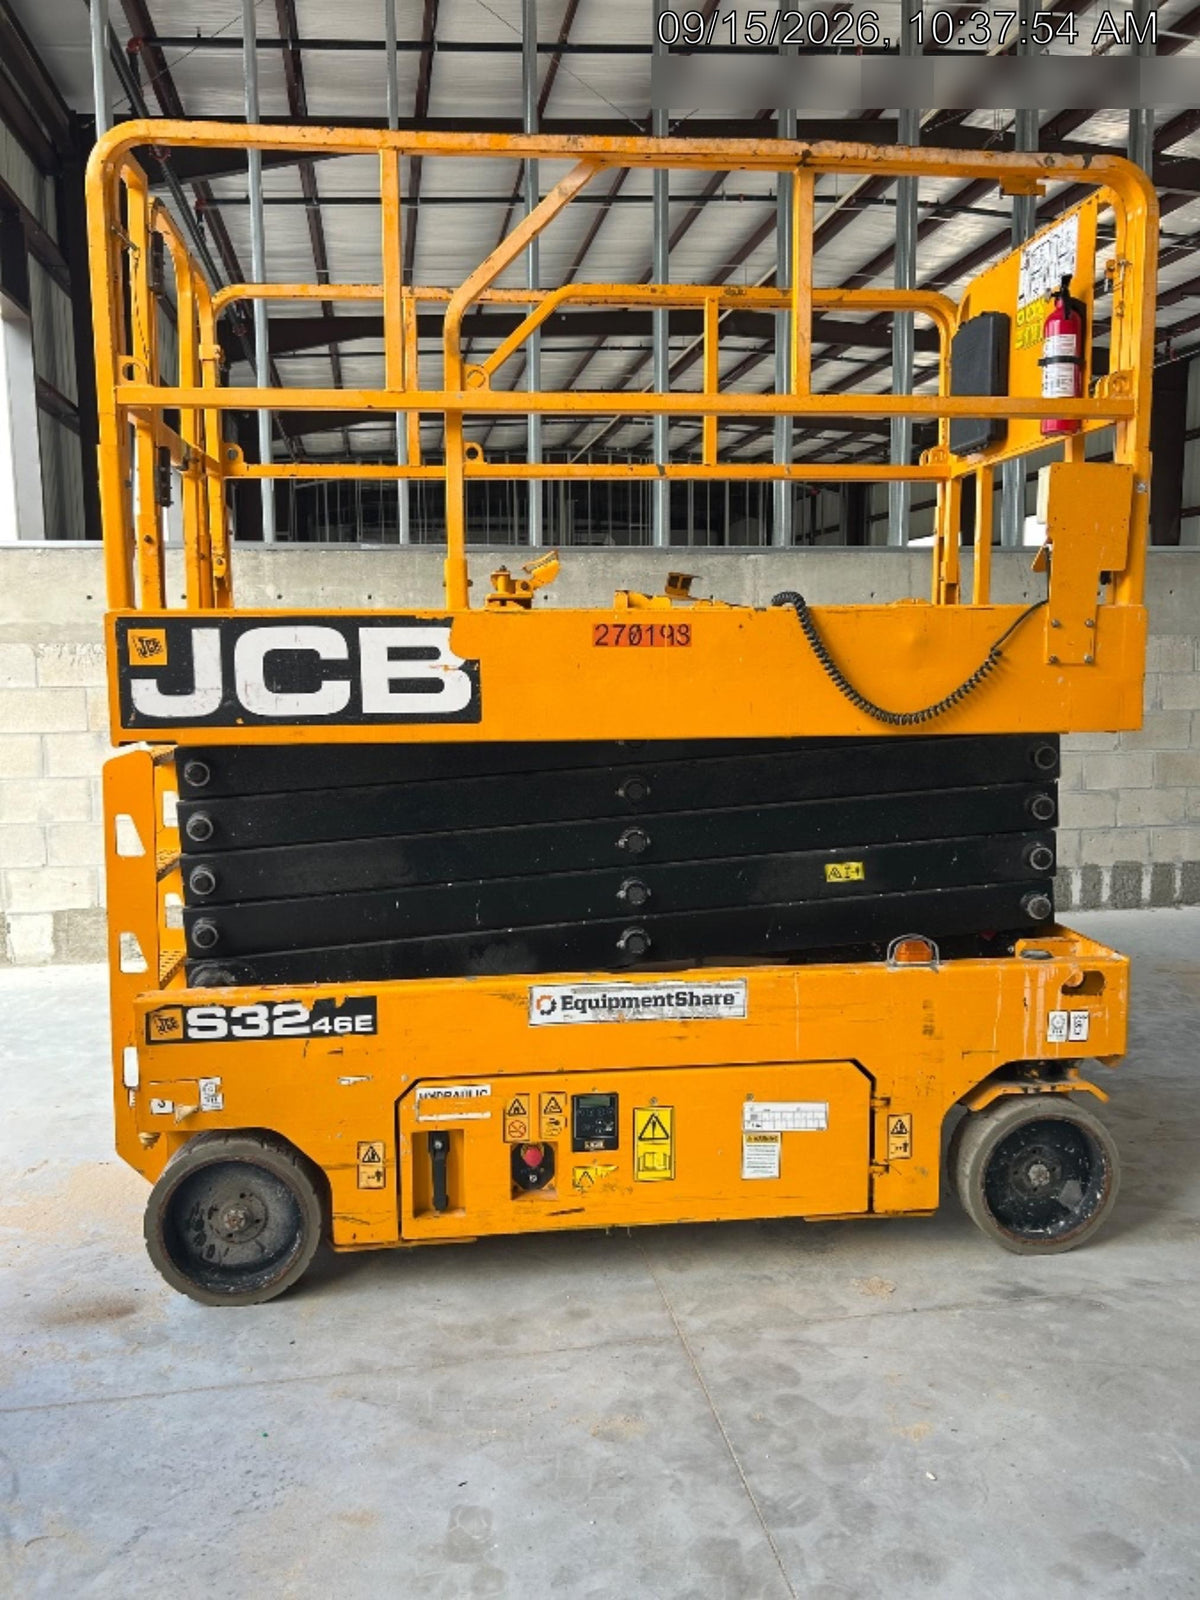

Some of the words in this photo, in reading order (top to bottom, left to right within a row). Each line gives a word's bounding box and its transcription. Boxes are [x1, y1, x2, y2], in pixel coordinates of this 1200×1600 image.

[594, 623, 691, 647] 270198
[130, 625, 472, 718] JCB
[560, 991, 736, 1012] EquipmentShare
